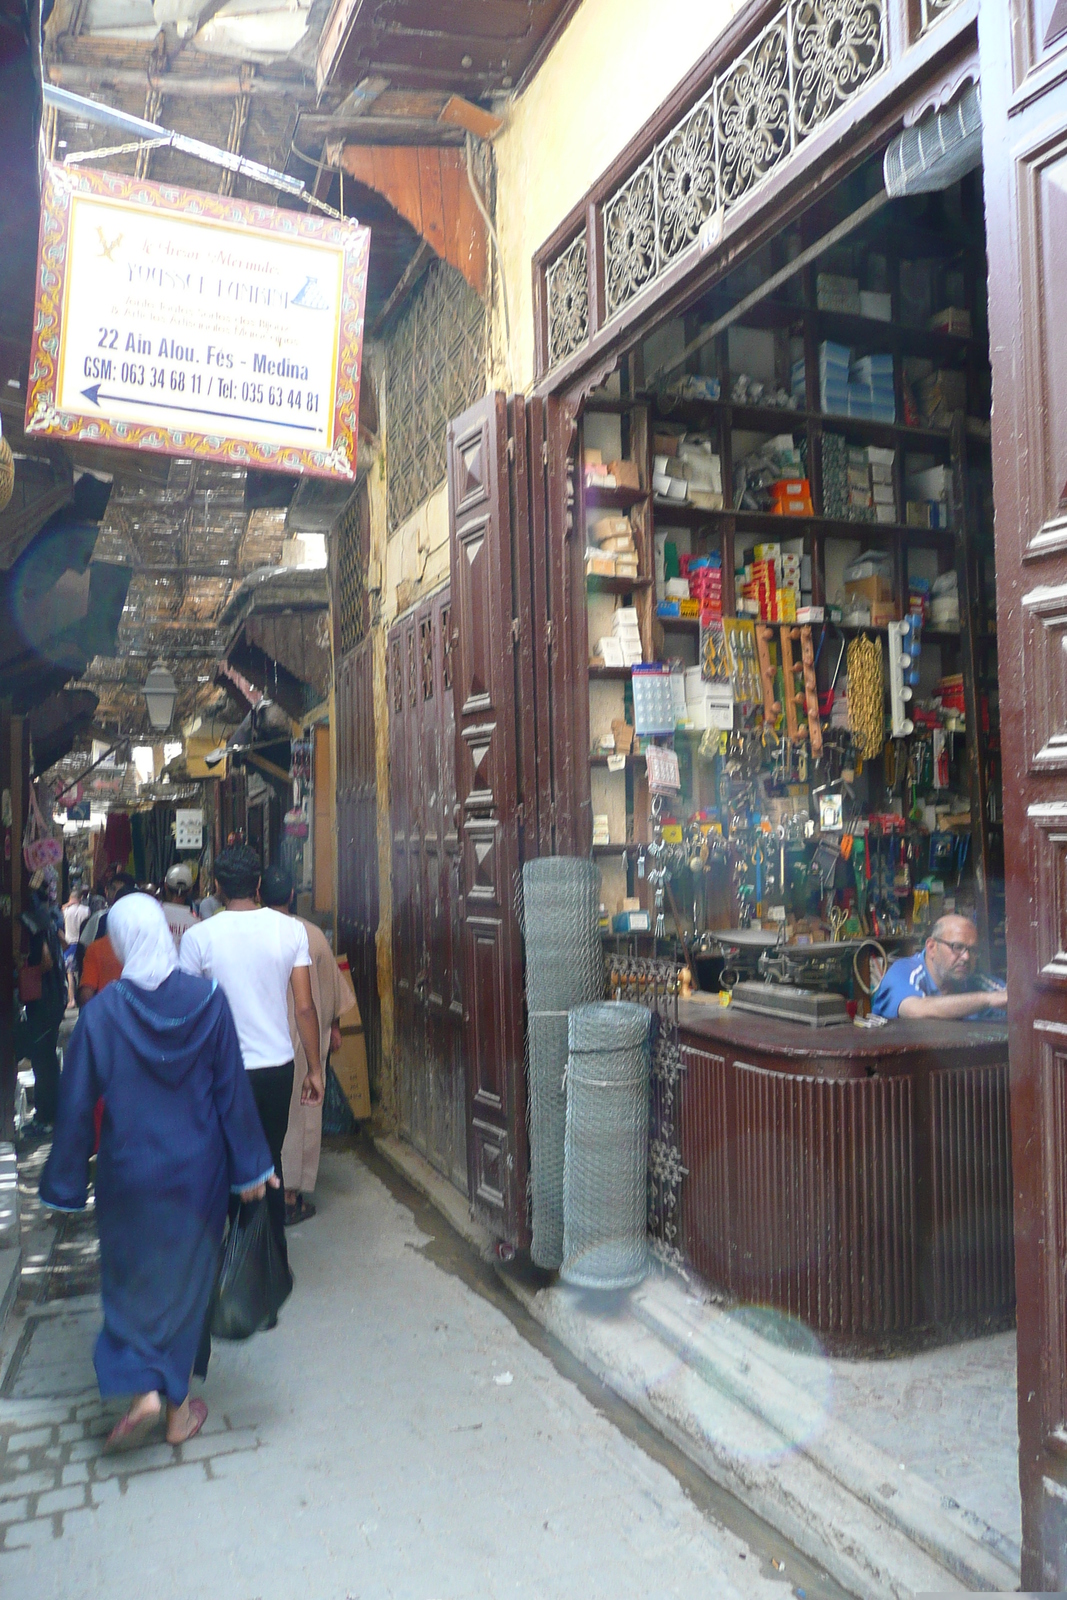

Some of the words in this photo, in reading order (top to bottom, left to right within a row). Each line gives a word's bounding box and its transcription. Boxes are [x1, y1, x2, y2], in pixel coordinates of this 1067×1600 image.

[98, 328, 118, 350] 22
[125, 332, 151, 355] Ain
[158, 338, 199, 362] Alou.
[254, 354, 308, 380] Medina
[84, 356, 116, 380] GSM:
[121, 362, 144, 385] 063
[150, 367, 164, 388] 34
[170, 370, 185, 392] 68
[192, 374, 201, 394] 11
[208, 377, 213, 395] /
[218, 378, 236, 399] Tel:
[242, 382, 263, 403] 035
[269, 386, 282, 406] 63
[287, 390, 301, 409] 44
[306, 392, 318, 412] 81
